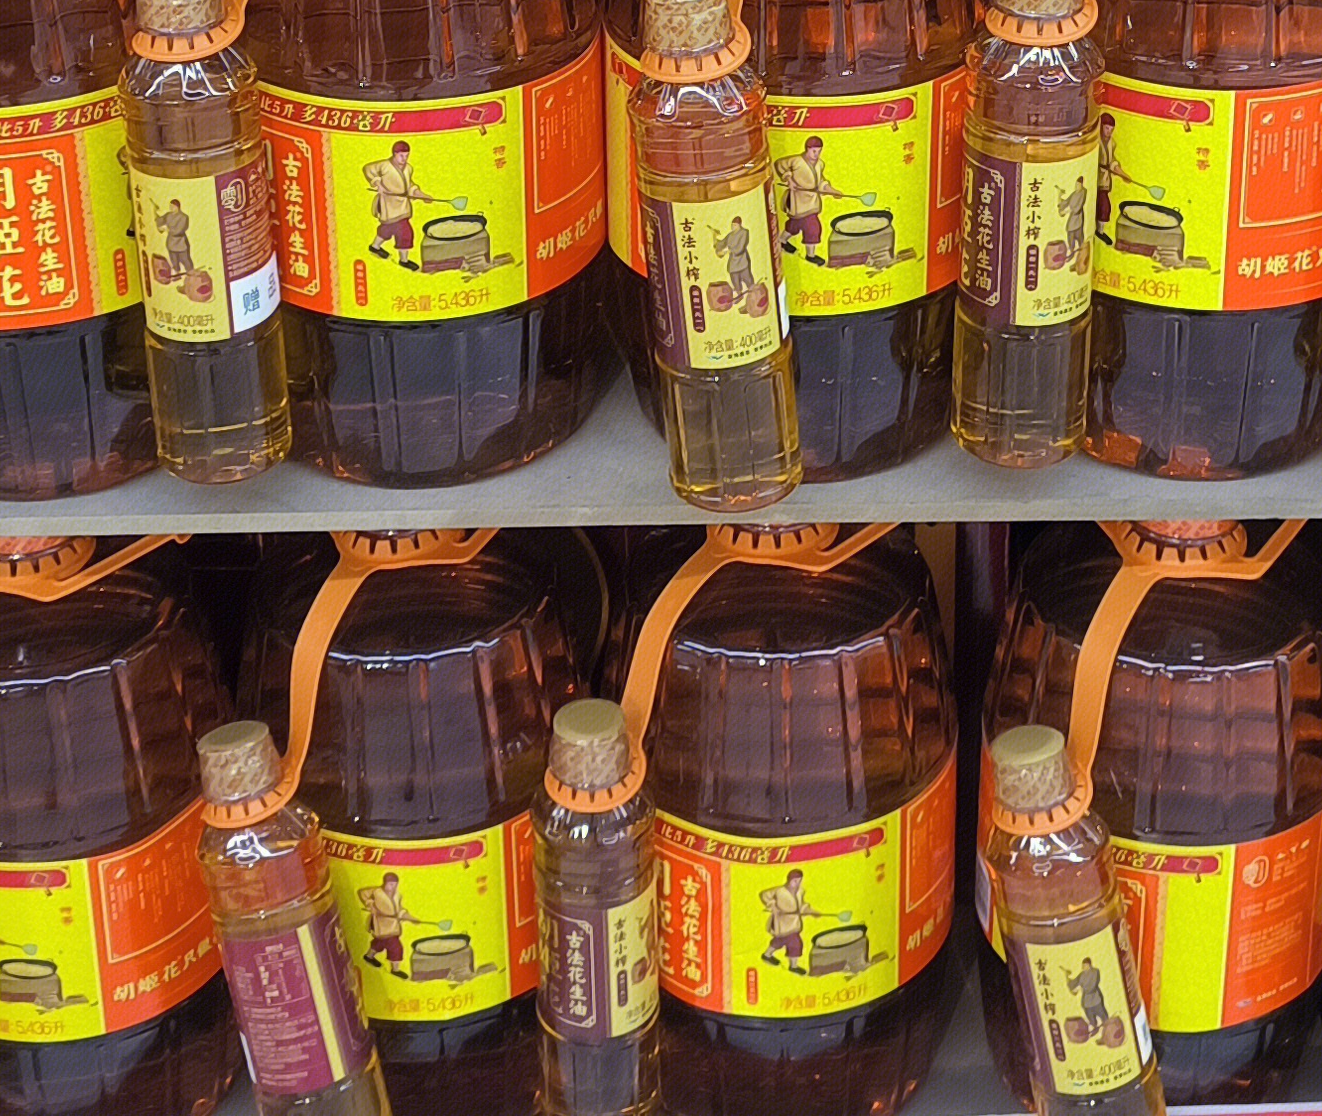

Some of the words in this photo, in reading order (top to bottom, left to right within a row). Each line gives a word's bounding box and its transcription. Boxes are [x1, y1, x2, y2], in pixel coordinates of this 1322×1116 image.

[26, 169, 65, 296] 古法花生油
[281, 152, 310, 279] 古法花生油
[679, 218, 703, 282] 古法小榨
[975, 184, 995, 291] 古法花生油
[1025, 177, 1044, 240] 古法小榨
[1090, 267, 1182, 301] 含量:5.436升
[566, 929, 589, 1017] 古法花生油
[679, 874, 701, 984] 古法花生油
